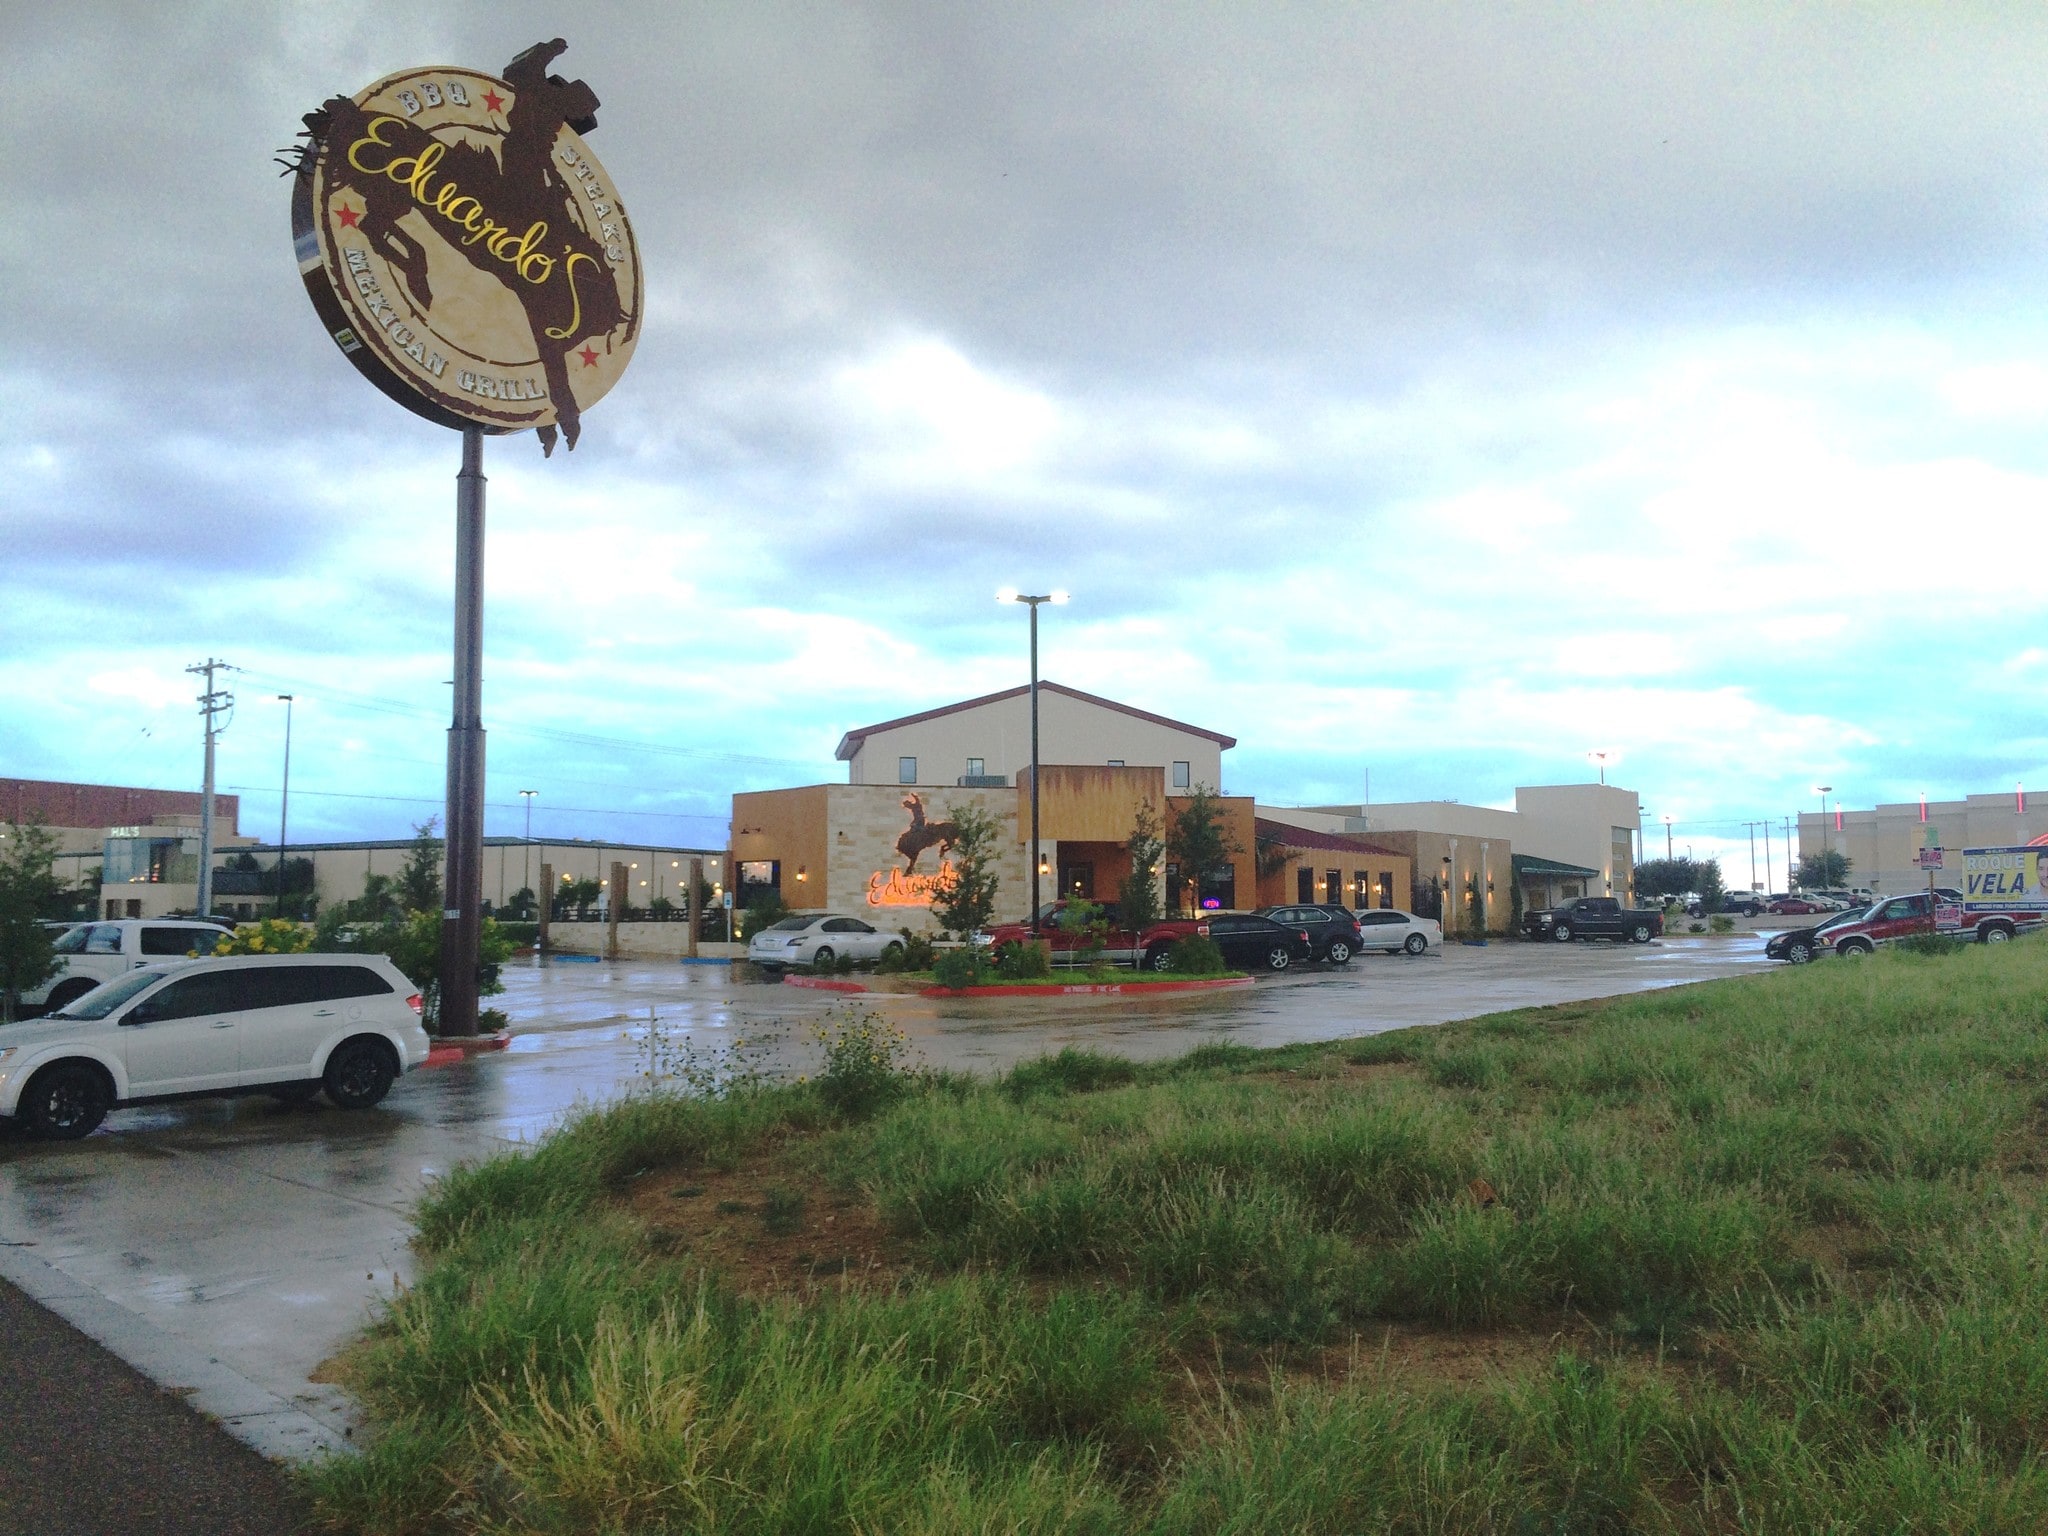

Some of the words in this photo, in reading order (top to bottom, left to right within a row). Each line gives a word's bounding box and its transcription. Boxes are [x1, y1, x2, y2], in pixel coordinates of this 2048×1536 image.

[395, 81, 471, 117] BBQ
[348, 116, 601, 340] Eduardo's
[560, 145, 624, 262] STEAKS
[344, 247, 449, 379] MEXICAN
[456, 368, 545, 401] GRILL
[1967, 854, 2025, 871] ROQUE
[1968, 872, 2025, 895] VELA
